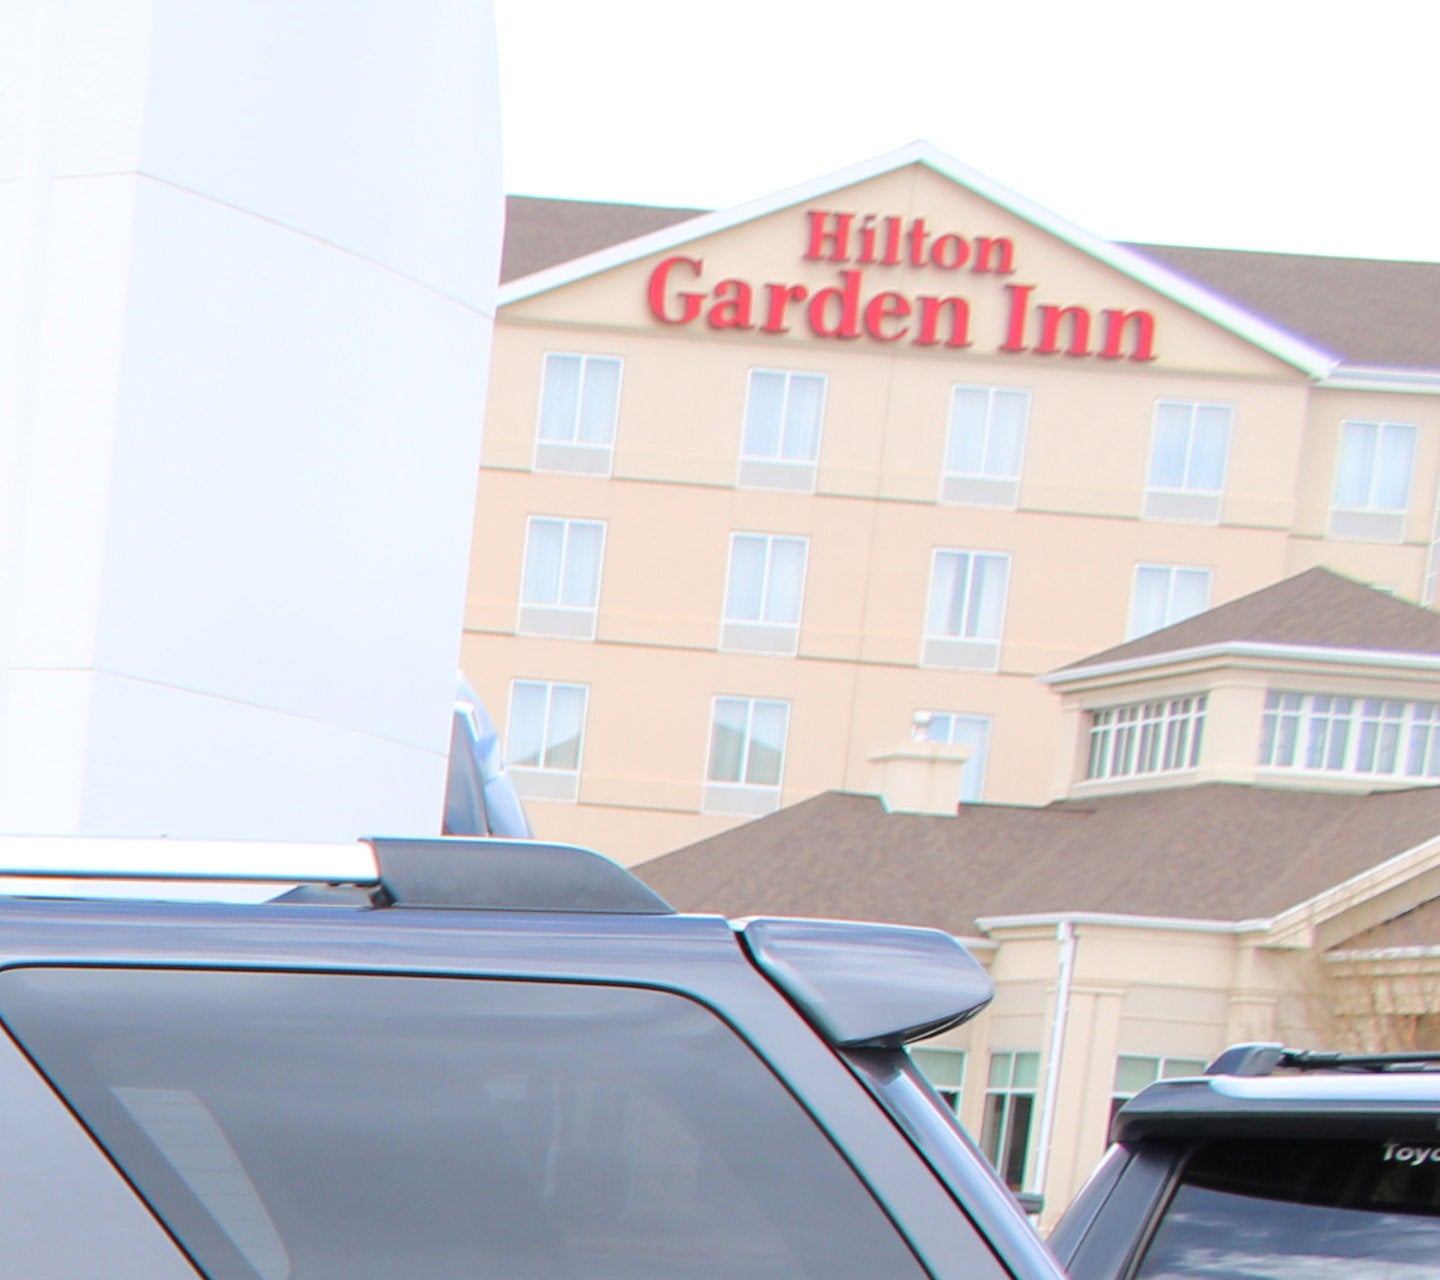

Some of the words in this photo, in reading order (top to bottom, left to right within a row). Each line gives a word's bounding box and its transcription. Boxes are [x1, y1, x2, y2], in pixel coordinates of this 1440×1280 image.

[803, 209, 1016, 275] Hilton
[648, 255, 973, 349] Garden
[998, 283, 1158, 363] Inn
